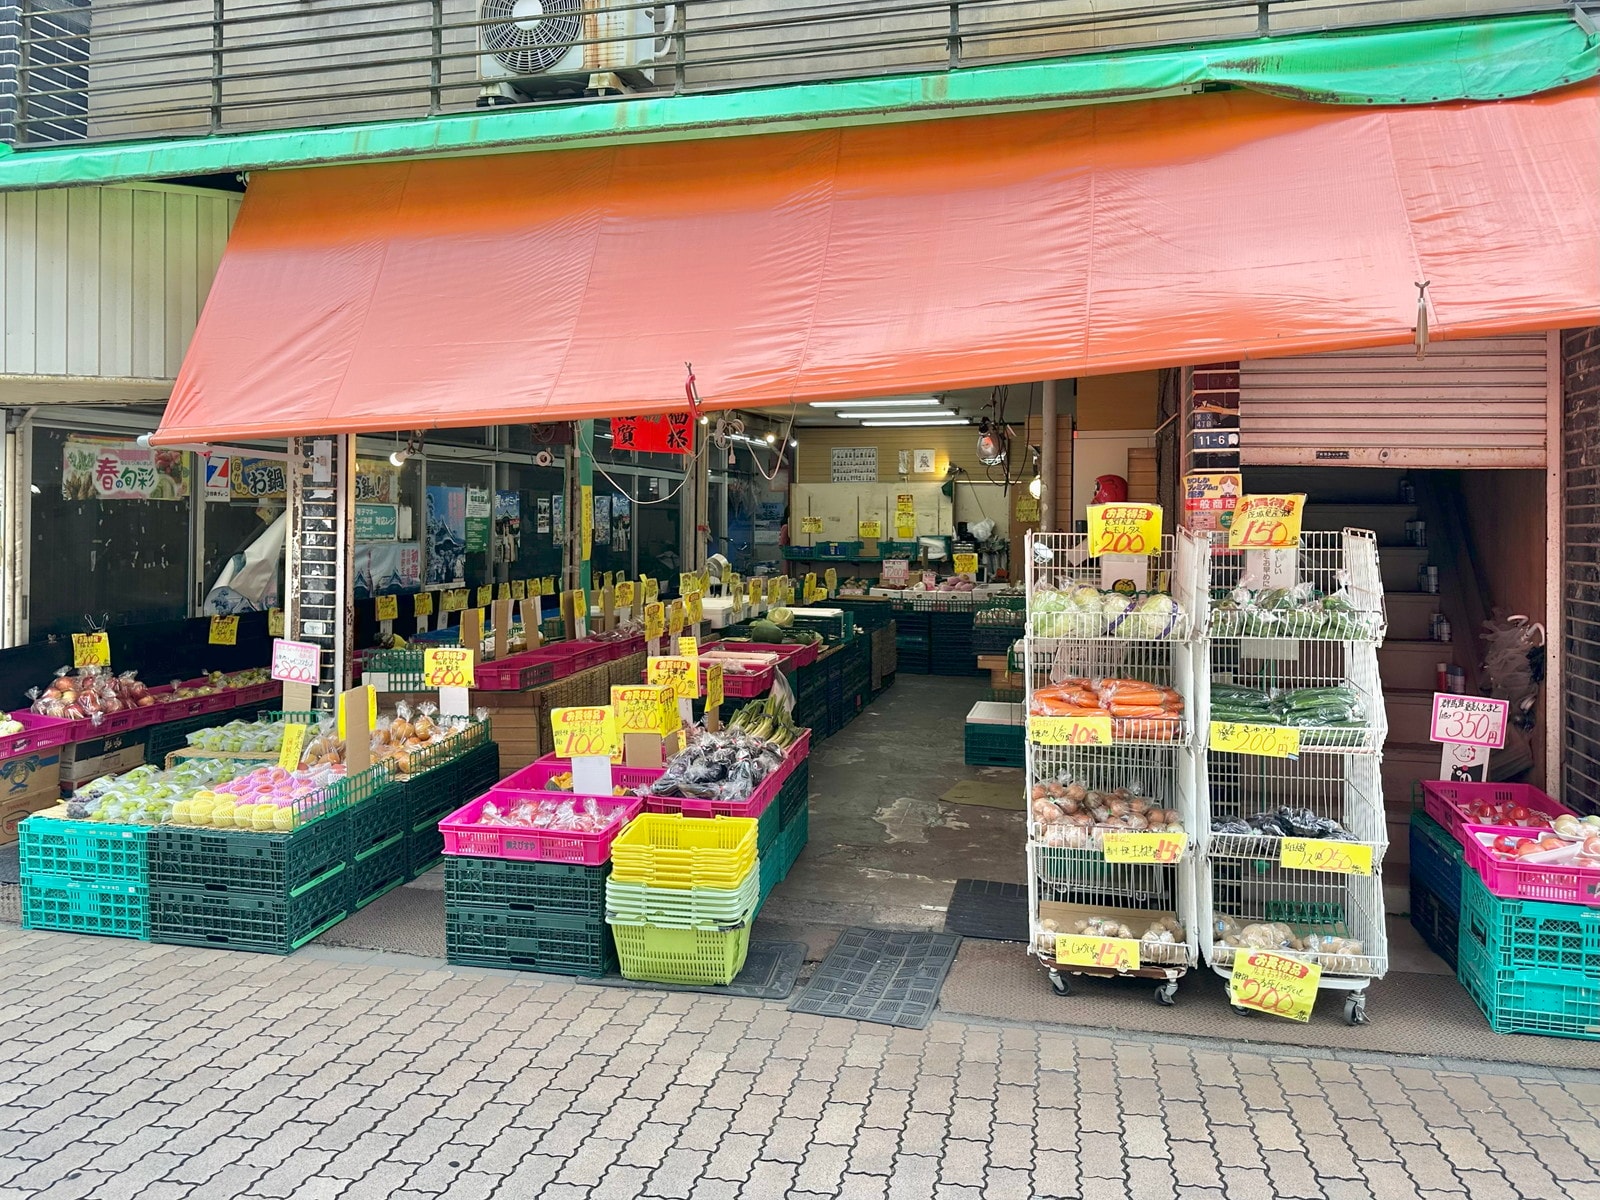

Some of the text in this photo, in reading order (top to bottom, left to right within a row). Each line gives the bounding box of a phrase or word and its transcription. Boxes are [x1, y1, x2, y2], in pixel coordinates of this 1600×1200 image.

[1199, 435, 1226, 446] 11-6
[95, 457, 156, 491] 春の旬彩
[1105, 508, 1148, 519] お買得品
[1190, 499, 1236, 509] 一般商店
[1241, 497, 1296, 512] お買得品
[1099, 531, 1145, 553] 200
[1241, 520, 1289, 546] 150
[430, 670, 465, 686] 600
[566, 711, 602, 721] お買得品
[622, 710, 658, 730] 200
[1243, 725, 1276, 735] きゅうり
[1445, 710, 1498, 744] 350円
[563, 731, 605, 755] 100
[1316, 847, 1353, 871] 250
[1254, 955, 1302, 976] お買得品
[1238, 978, 1294, 1013] 200
